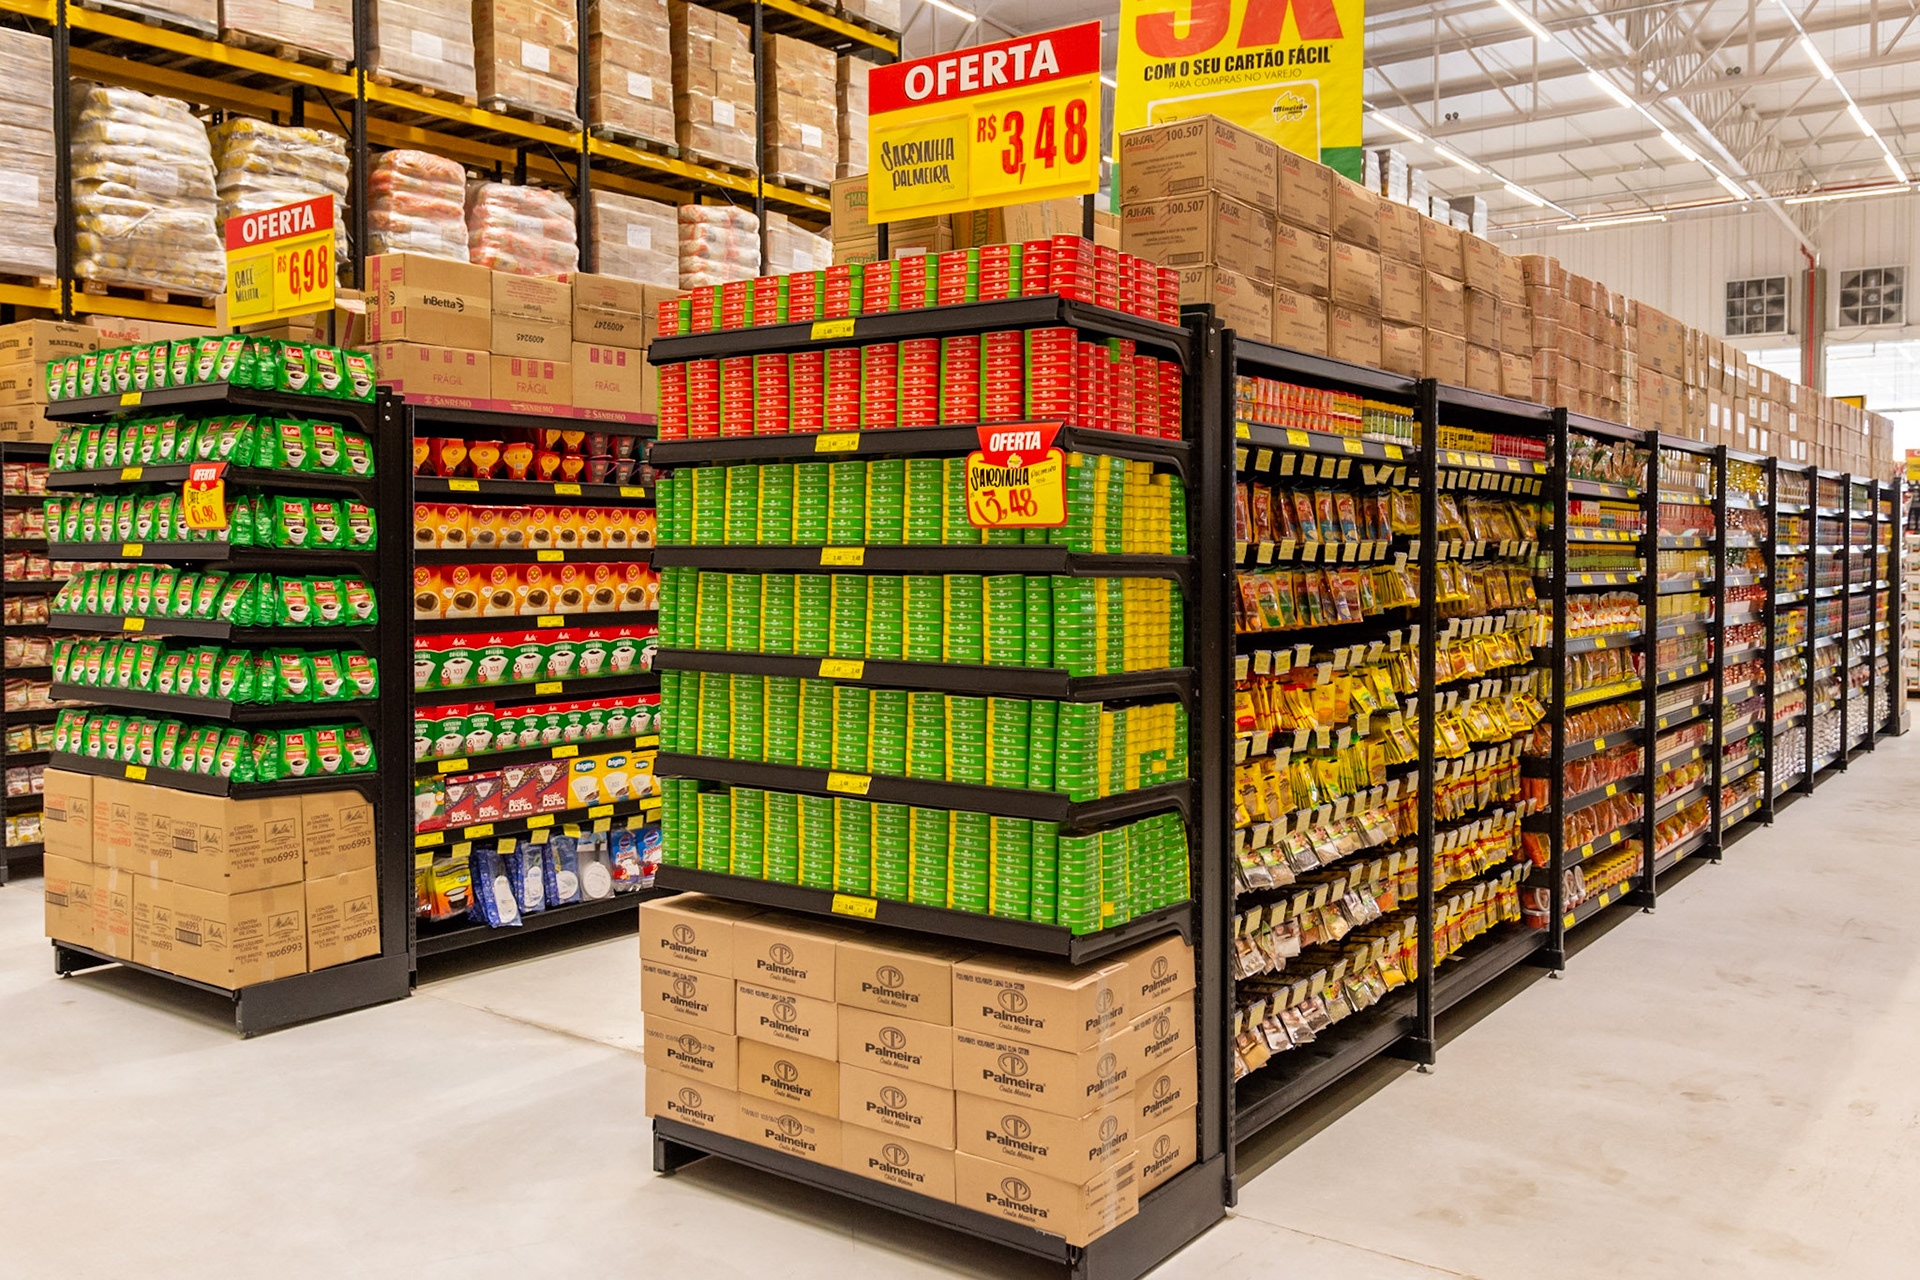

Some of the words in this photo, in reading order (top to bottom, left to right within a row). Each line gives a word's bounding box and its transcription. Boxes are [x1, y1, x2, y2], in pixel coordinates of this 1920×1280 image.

[904, 39, 1060, 100] OFERTA
[1144, 61, 1176, 82] COM
[1180, 60, 1190, 77] O
[1193, 56, 1220, 76] SEU
[1225, 48, 1284, 73] CARTÃO
[1169, 80, 1192, 90] PARA
[1195, 75, 1242, 88] COMPRAS
[1245, 73, 1261, 82] NO
[1263, 68, 1303, 80] VAREJO
[976, 113, 997, 143] R$
[1001, 98, 1088, 185] 3,48
[1165, 125, 1204, 142] 100.507
[881, 137, 955, 171] SARDINHA
[892, 164, 951, 191] PALMEIRA
[1167, 200, 1205, 215] 100.507
[242, 204, 316, 243] OFERTA
[234, 264, 254, 288] CAFÉ
[289, 245, 328, 301] 6,98
[423, 295, 456, 309] InBetta
[594, 320, 624, 332] 4009247
[516, 333, 545, 344] 4009245
[433, 371, 463, 387] FRÁGIL
[516, 380, 548, 395] FRÁGIL
[595, 380, 621, 393] FRÁGIL
[434, 396, 472, 408] SANREMO
[521, 403, 554, 415] SANREMO
[592, 410, 626, 422] SANREMO
[989, 431, 1041, 452] OFERTA
[193, 468, 216, 482] OFERTA
[970, 467, 1029, 491] SARDINHA
[191, 505, 217, 525] 6,98
[975, 488, 1038, 524] 3,48
[589, 657, 598, 665] 103
[661, 939, 709, 958] Palmeira
[757, 959, 808, 979] Palmeira
[862, 982, 920, 1003] Palmeira
[1142, 970, 1178, 996] Palmeira
[662, 992, 709, 1012] Palmeira
[760, 1016, 811, 1038] Palmeira
[982, 1005, 1045, 1029] Palmeira
[865, 1042, 922, 1065] Palmeira
[1144, 1029, 1180, 1057] Palmeira
[667, 1048, 715, 1069] Palmeira
[761, 1073, 812, 1098] Palmeira
[983, 1068, 1046, 1093] Palmeira
[1086, 1067, 1128, 1096] Palmeira
[667, 1100, 715, 1123] Palmeira
[866, 1101, 923, 1125] Palmeira
[1142, 1088, 1181, 1117] Palmeira
[765, 1128, 817, 1152] Palmeira
[986, 1130, 1049, 1156] Palmeira
[1089, 1129, 1129, 1160] Palmeira
[869, 1158, 925, 1183] Palmeira
[1143, 1146, 1180, 1177] Palmeira
[986, 1192, 1049, 1219] Palmeira
